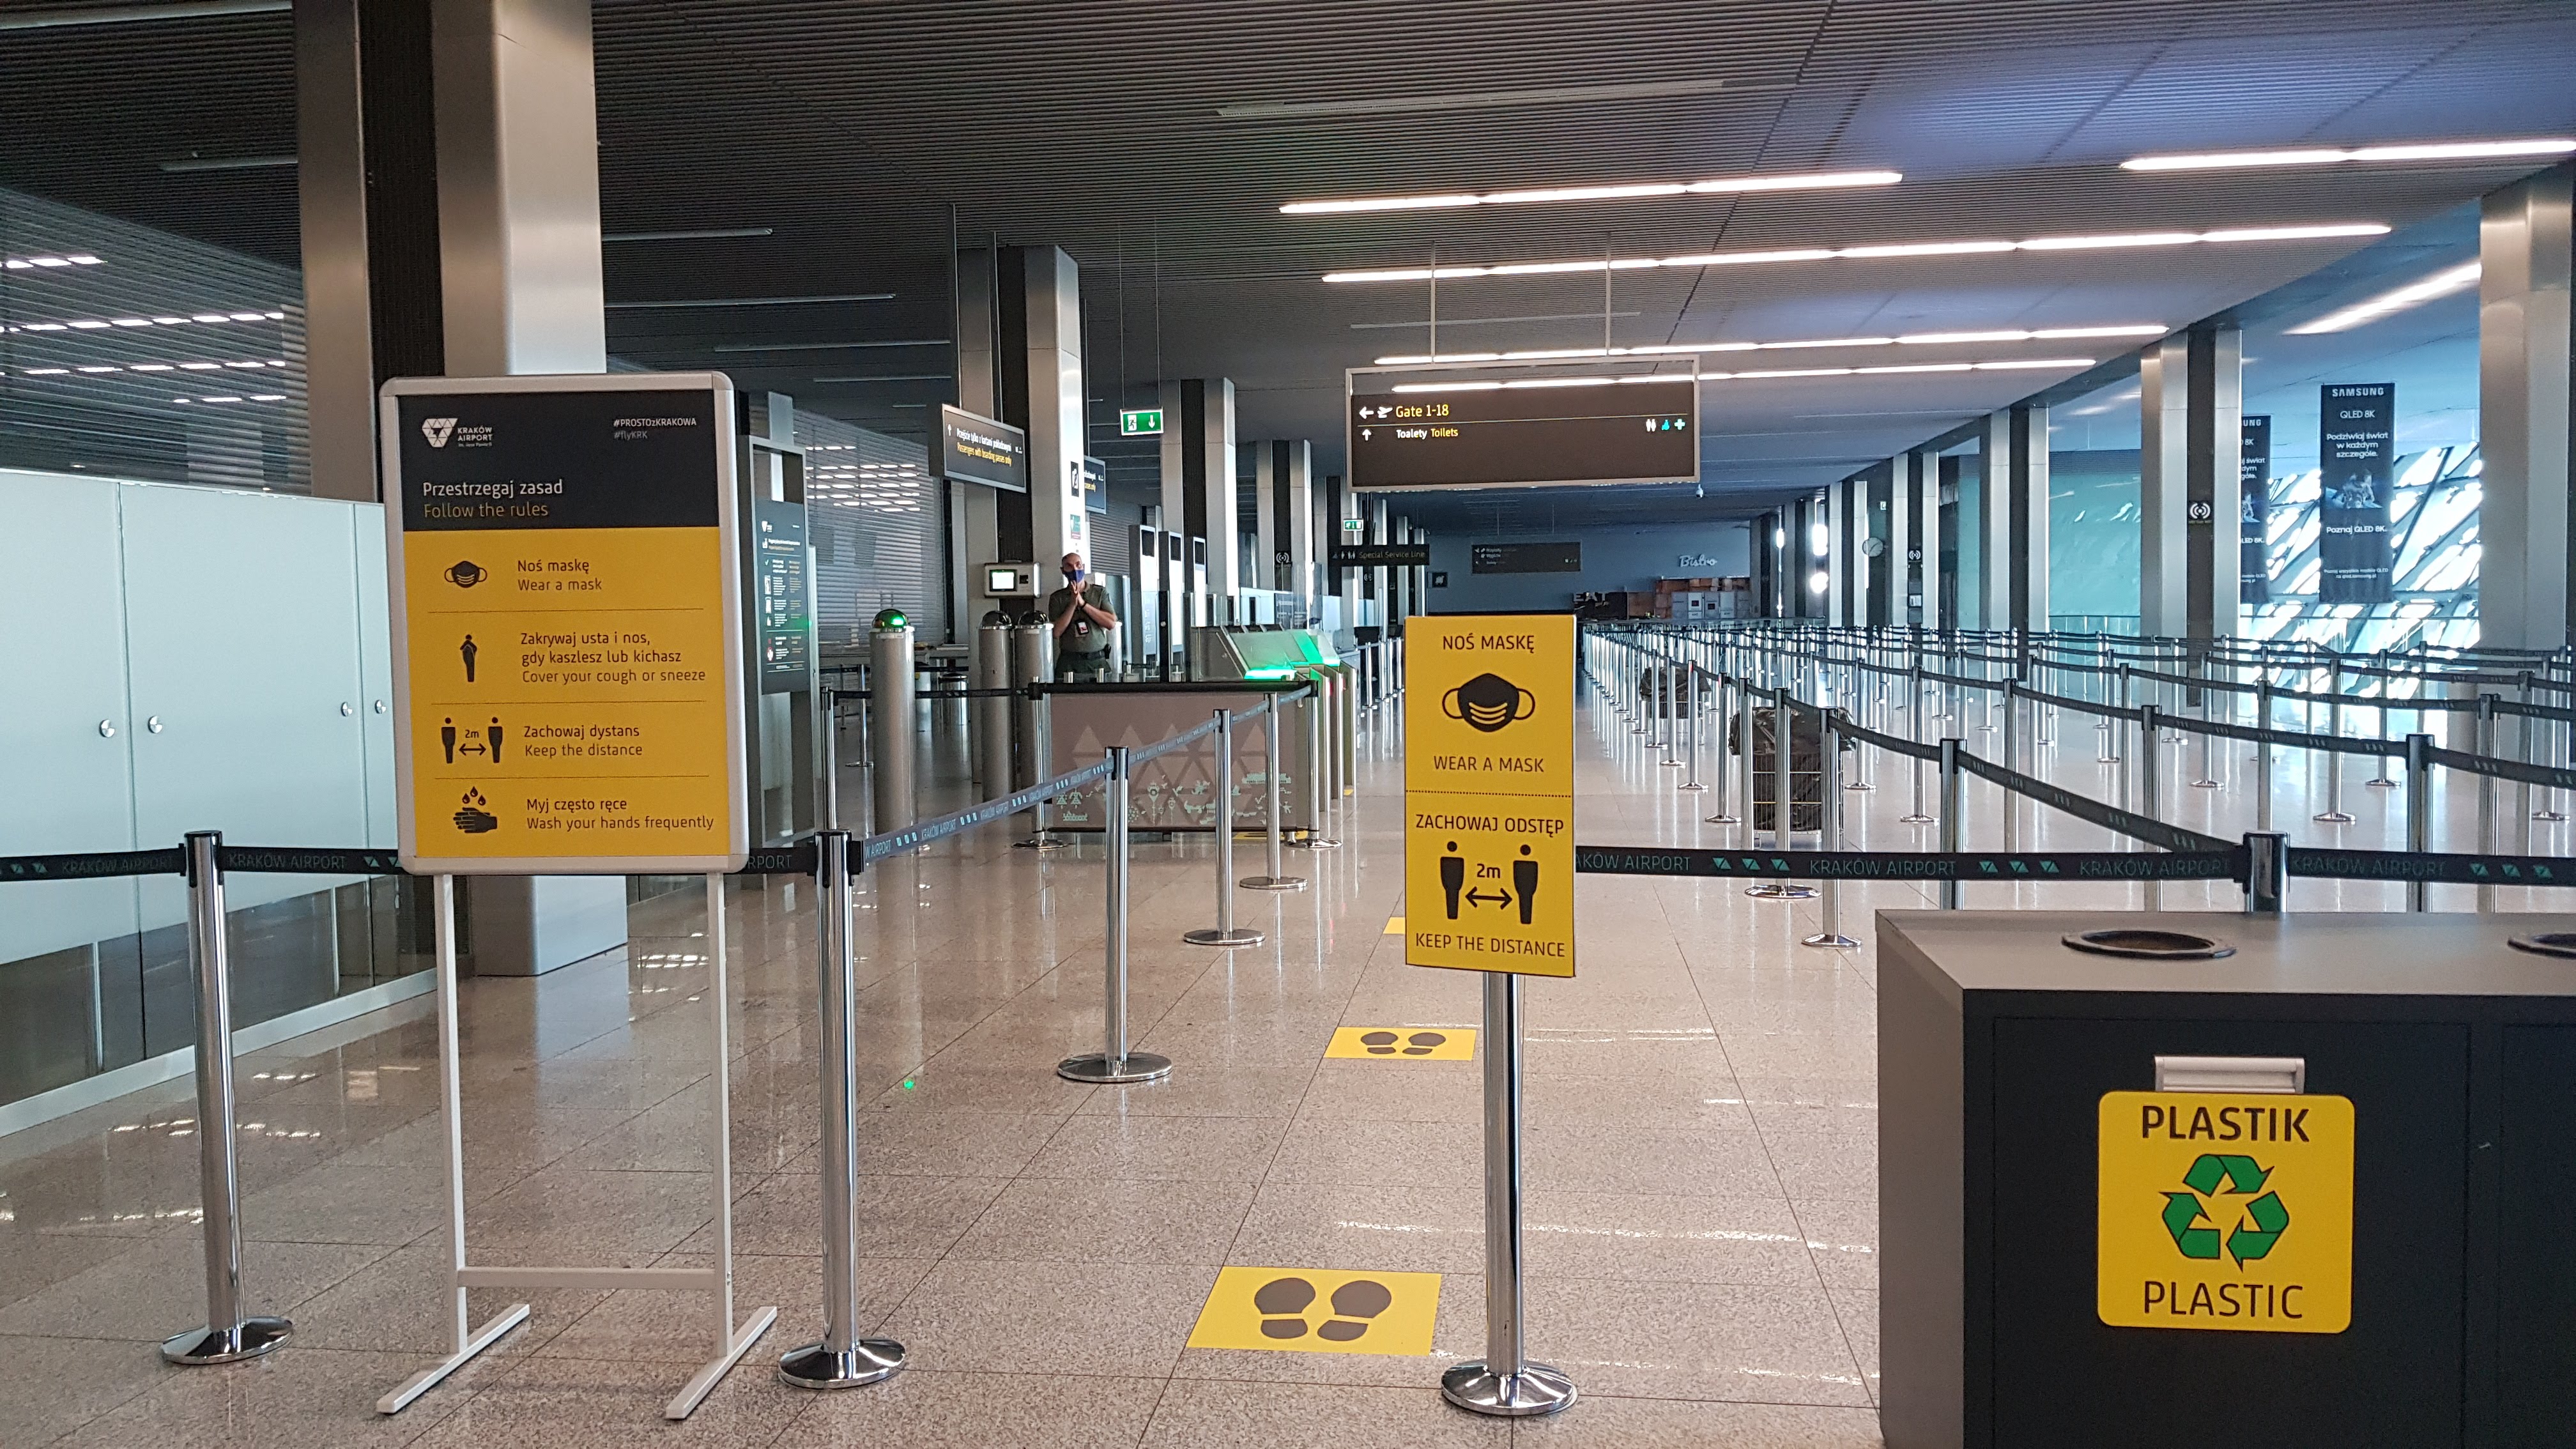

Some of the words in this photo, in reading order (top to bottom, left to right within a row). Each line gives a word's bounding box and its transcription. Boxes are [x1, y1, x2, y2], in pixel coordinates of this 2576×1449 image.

[2332, 387, 2384, 397] SAMSUNG
[1395, 404, 1422, 418] Gate
[1426, 404, 1449, 417] 1-18
[2340, 410, 2363, 418] QLED
[2364, 410, 2375, 418] 8K
[456, 424, 493, 434] KRAKÓW
[613, 417, 698, 427] #PROSTOzKRAKOWA
[613, 430, 648, 441] #flyKRK
[1396, 429, 1427, 440] Toalety
[1430, 427, 1459, 438] Toilets
[2327, 433, 2365, 441] Podziwiaj
[2346, 441, 2379, 450] każdym
[423, 480, 514, 499] Przestrzegaj
[519, 479, 563, 494] zasad
[424, 500, 473, 518] Follow
[479, 500, 505, 517] the
[510, 501, 548, 517] rules
[2326, 526, 2352, 534] Poznaj
[1385, 551, 1409, 559] Service
[1679, 555, 1717, 567] Bistro
[518, 559, 543, 572] Noś
[548, 558, 590, 574] maskę
[518, 579, 551, 591] Wear
[555, 581, 562, 591] a
[568, 577, 602, 590] mask
[1574, 592, 1609, 602] EAT
[521, 631, 576, 648] Zakrywaj
[581, 632, 609, 644] usta
[614, 631, 617, 643] i
[623, 634, 650, 646] nos,
[1443, 632, 1475, 650] NOŚ
[1481, 635, 1535, 654] MASKĘ
[521, 650, 545, 668] gdy
[549, 650, 602, 664] kaszlesz
[607, 649, 628, 663] lub
[634, 649, 682, 663] kichasz
[523, 670, 558, 683] Cover
[562, 673, 592, 686] your
[596, 669, 637, 685] cough
[642, 671, 656, 682] or
[660, 671, 706, 681] sneeze
[464, 729, 479, 739] 2m
[524, 724, 585, 740] Zachowaj
[590, 724, 640, 740] dystans
[525, 744, 556, 759] Keep
[562, 743, 583, 756] the
[588, 742, 643, 756] distance
[1433, 755, 1477, 771] WEAR
[1482, 756, 1492, 772] A
[1499, 757, 1544, 772] MASK
[526, 798, 549, 814] Myj
[554, 798, 595, 813] często
[600, 800, 627, 813] ręce
[526, 816, 562, 829] Wash
[566, 819, 595, 832] your
[601, 815, 640, 829] hands
[645, 815, 714, 831] frequently
[1416, 814, 1498, 831] ZACHOWAJ
[1505, 817, 1564, 838] ODSTĘP
[871, 839, 891, 857] AIRPORT
[291, 855, 345, 870] AIRPORT
[748, 855, 792, 869] RPORT
[1576, 851, 1619, 870] AKÓW
[1625, 855, 1690, 871] AIRPORT
[1809, 856, 1880, 875] KRAKÓW
[1886, 860, 1956, 876] AIRPORT
[2080, 859, 2153, 876] KRAKÓW
[2159, 860, 2230, 876] AIRPORT
[1476, 863, 1501, 879] 2m
[1416, 932, 1452, 949] KEEP
[1456, 935, 1484, 951] THE
[1491, 938, 1565, 957] DISTANCE
[2142, 1105, 2310, 1142] PLASTIK
[2144, 1280, 2303, 1319] PLASTIC
